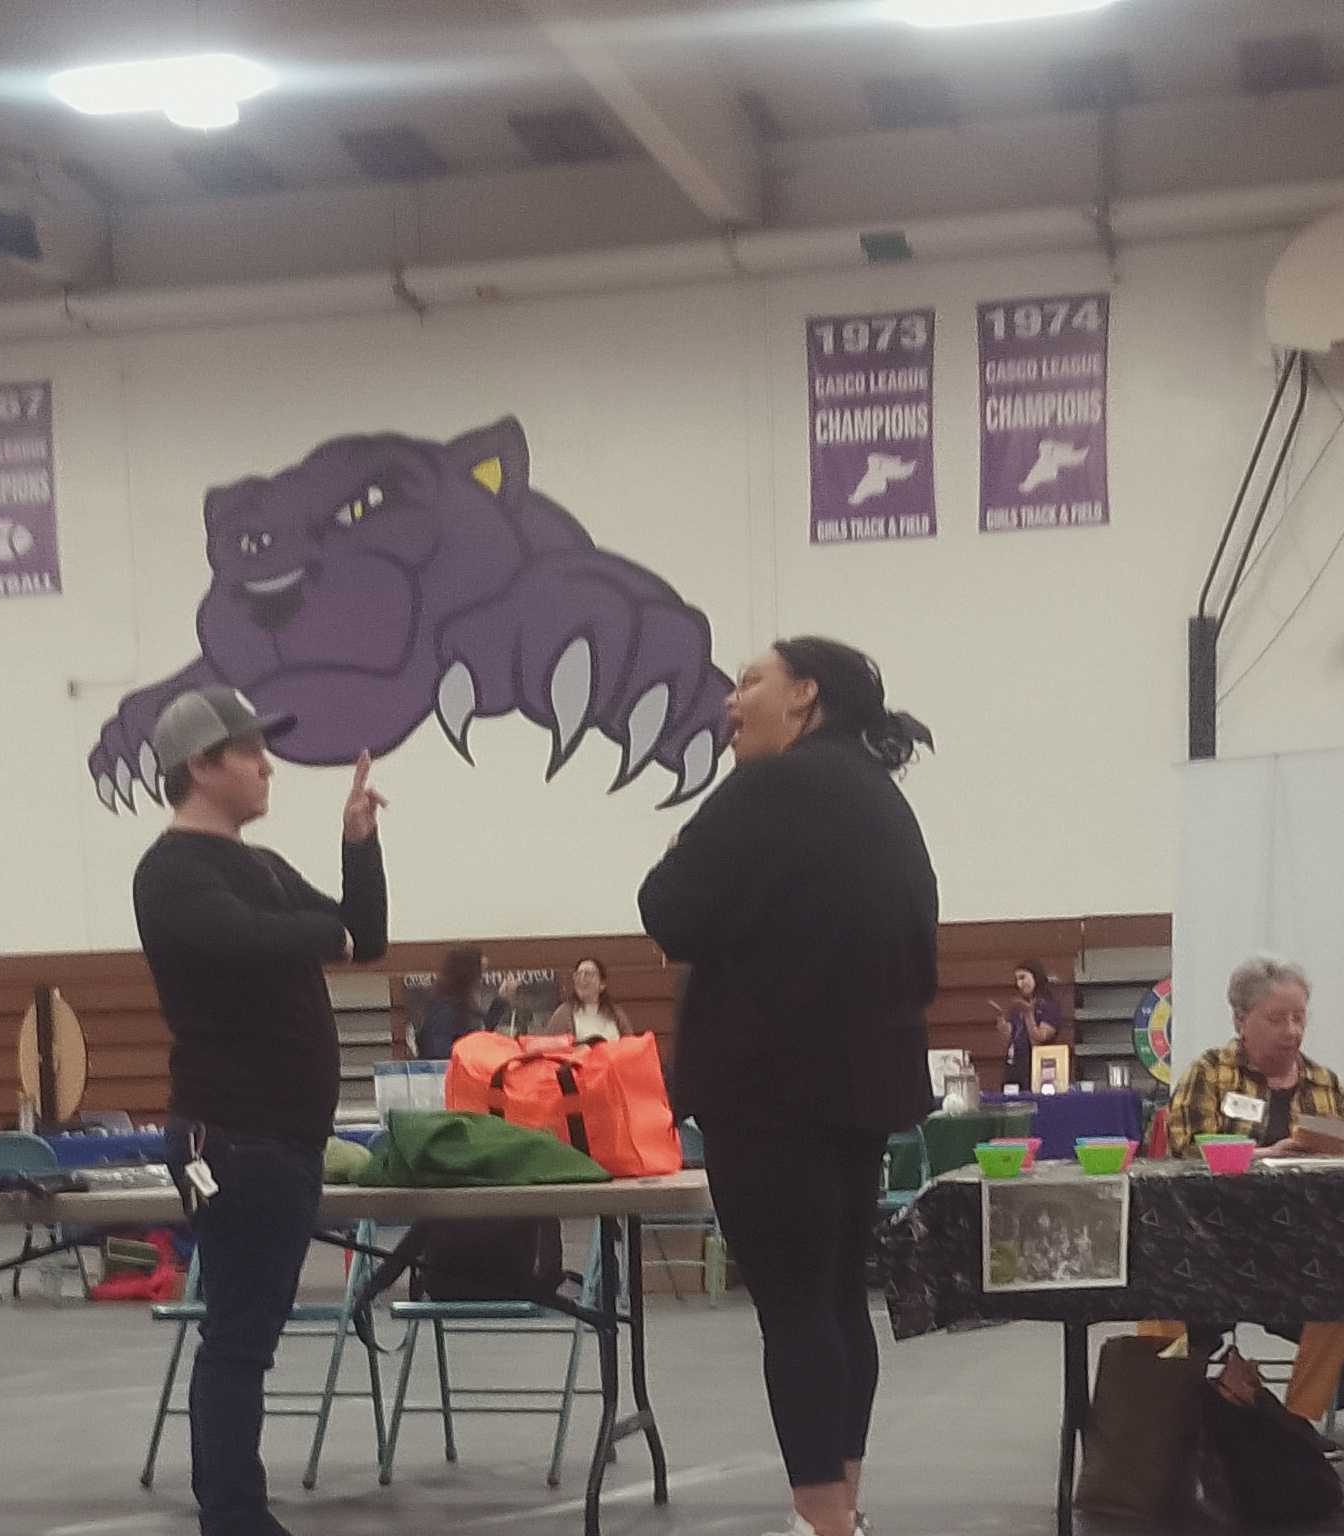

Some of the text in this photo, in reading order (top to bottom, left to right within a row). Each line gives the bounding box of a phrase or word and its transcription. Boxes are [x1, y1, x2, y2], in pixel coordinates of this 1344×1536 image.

[815, 314, 927, 356] 1973
[985, 300, 1100, 342] 1974
[816, 404, 928, 444] CHAMPIONS
[986, 389, 1102, 433] CHAMPIONS
